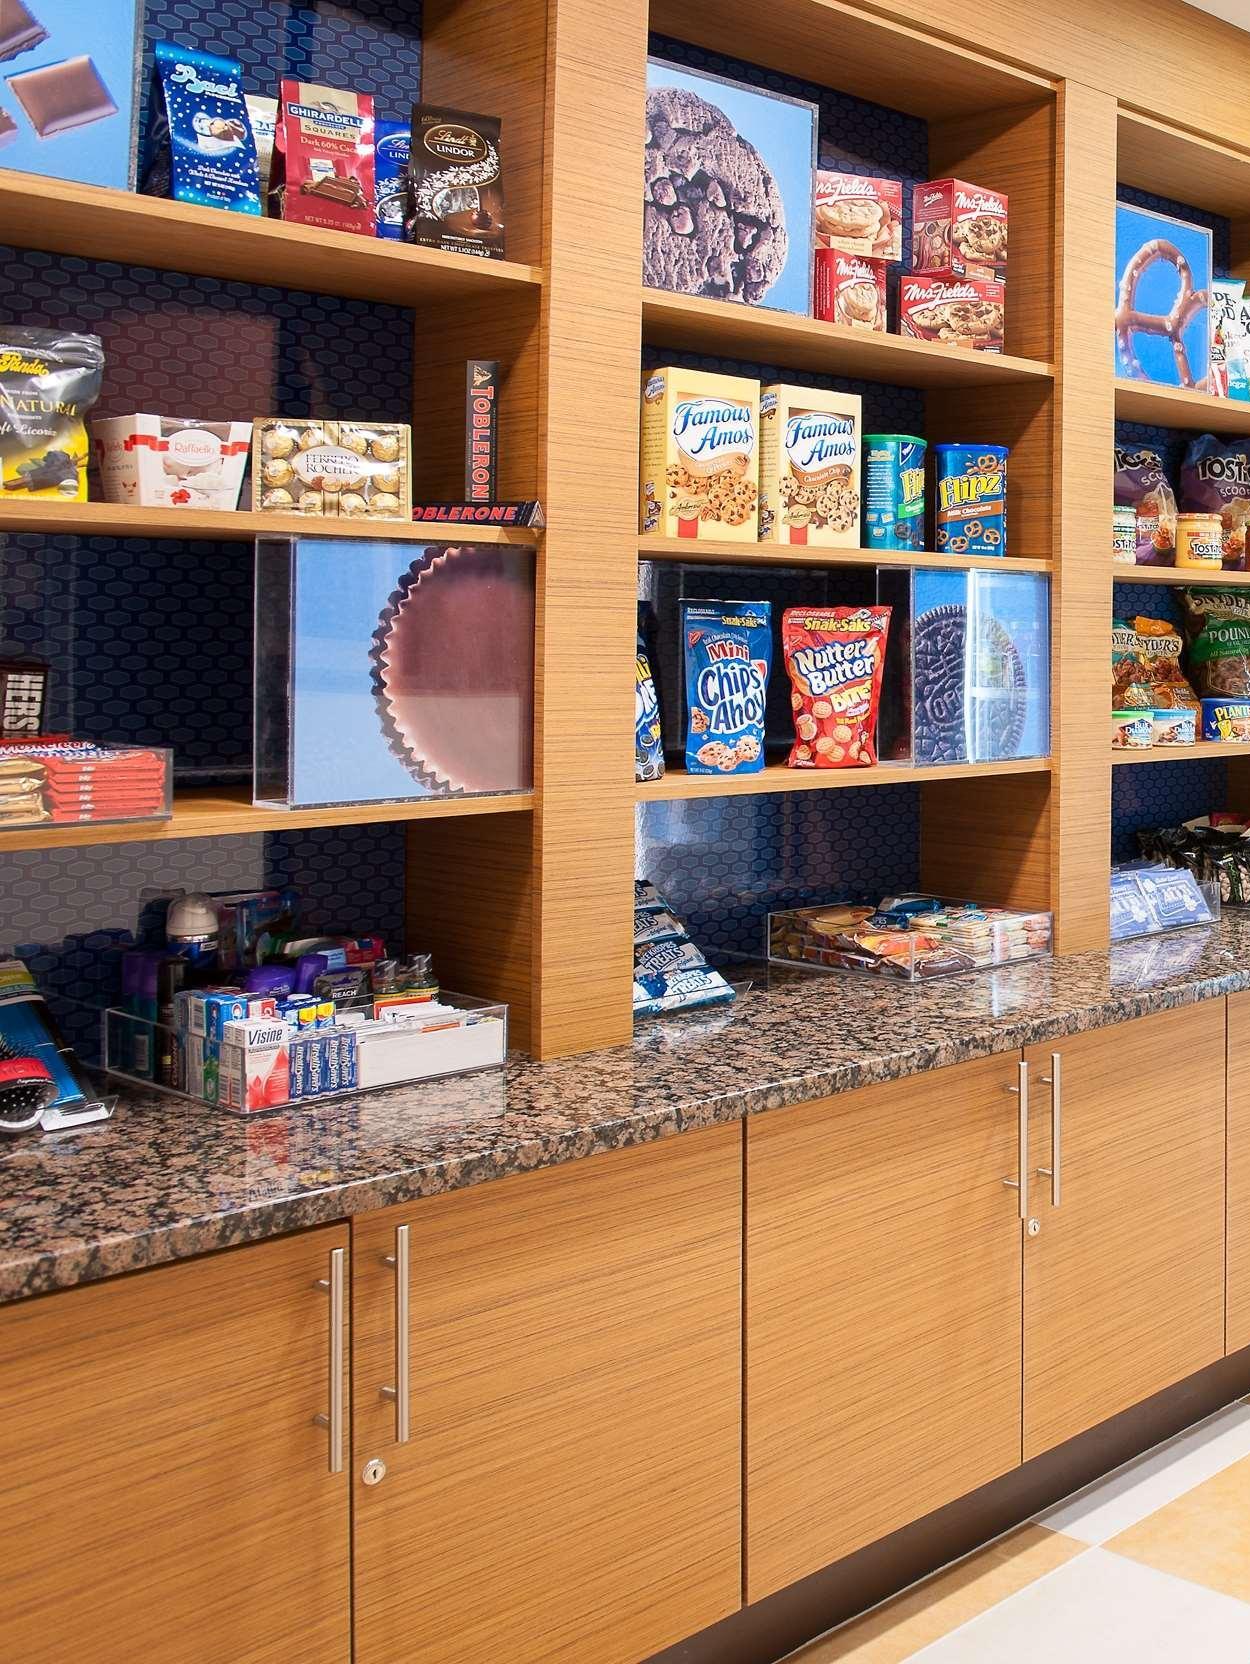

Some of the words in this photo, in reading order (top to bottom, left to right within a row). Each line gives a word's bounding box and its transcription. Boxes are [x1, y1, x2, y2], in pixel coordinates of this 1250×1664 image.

[170, 63, 239, 97] Baci
[290, 105, 364, 127] GHIRARDELL
[304, 124, 357, 140] SQUARES
[434, 129, 470, 146] Lindt
[300, 136, 321, 147] Dark
[339, 143, 358, 154] Cac
[388, 138, 410, 150] Lin
[436, 144, 476, 158] LINDOR
[389, 151, 410, 160] LIN
[673, 400, 751, 436] Famous
[691, 426, 755, 455] Amos
[785, 415, 854, 449] Famous
[470, 385, 495, 502] TOBLERON
[801, 438, 856, 467] Amos
[939, 472, 1003, 513] Flipz
[412, 505, 518, 521] OBLERONE
[961, 505, 992, 515] Chocolate
[804, 617, 872, 632] Snak-Saks
[706, 640, 749, 663] Mini
[794, 639, 867, 675] Nutter
[698, 662, 763, 710] Chips
[806, 656, 876, 696] Butter
[645, 947, 686, 973] TREATS
[331, 989, 358, 1000] REACH
[248, 1027, 283, 1046] Visine
